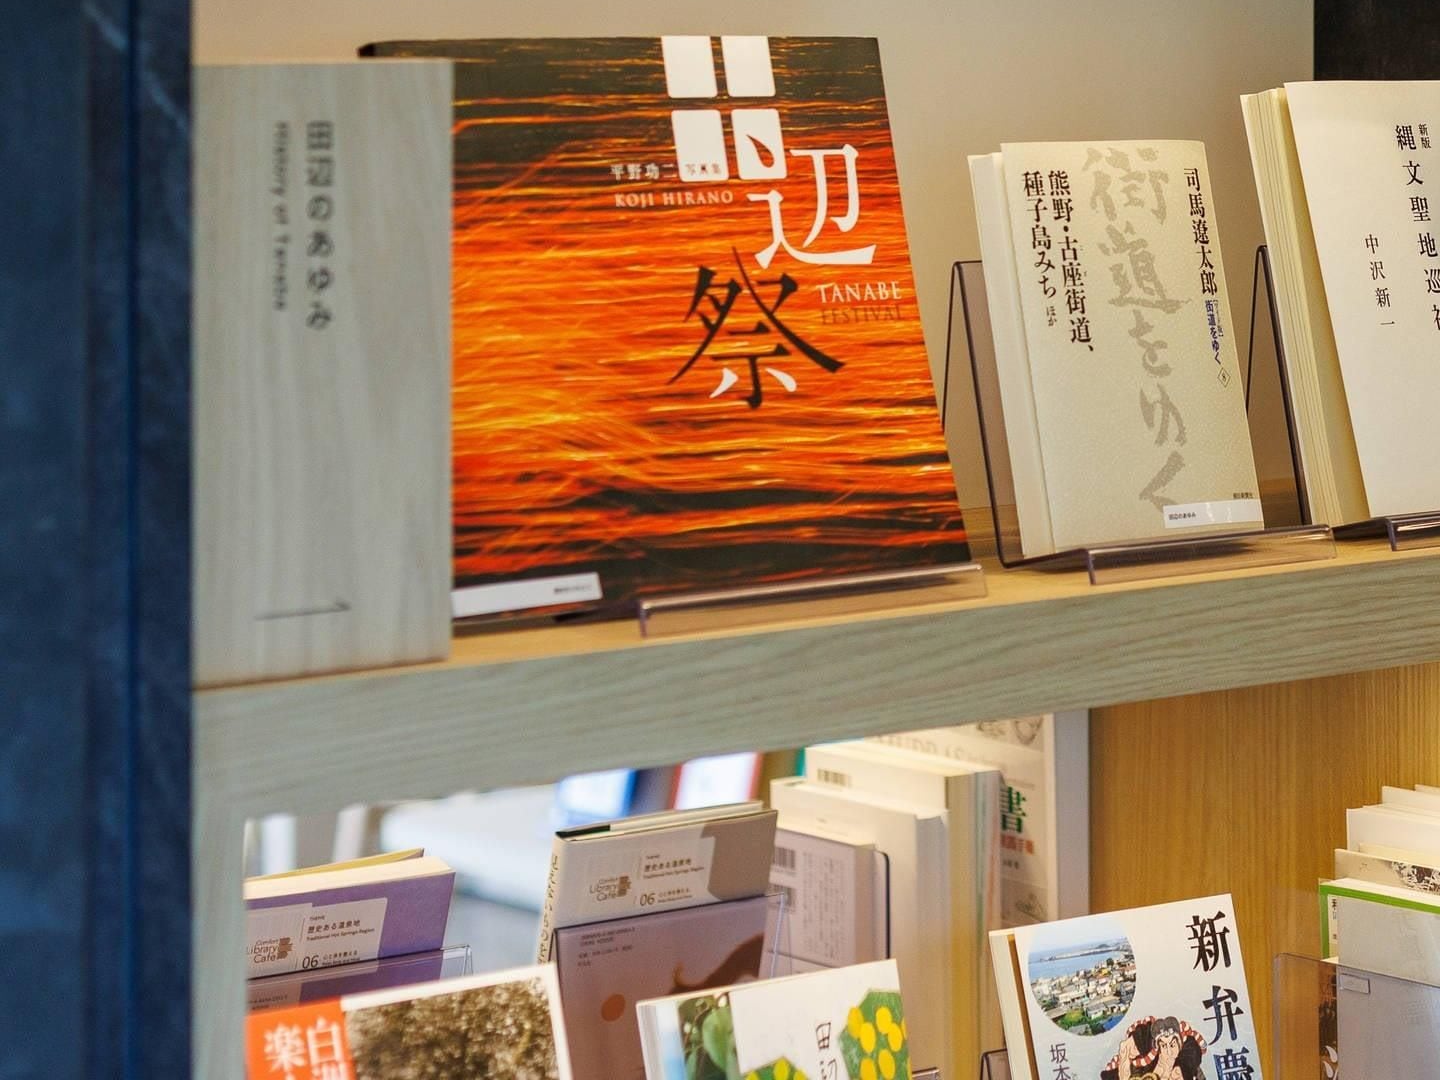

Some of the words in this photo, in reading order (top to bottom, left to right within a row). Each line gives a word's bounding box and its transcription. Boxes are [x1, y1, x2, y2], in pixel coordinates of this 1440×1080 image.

[1418, 123, 1432, 149] 新版
[614, 192, 655, 208] KOJI
[662, 190, 734, 206] HIRANO
[306, 121, 335, 331] 田辺のあゆみ
[1023, 170, 1057, 299] 種子島みち
[1183, 168, 1218, 296] 司馬遼太郎
[816, 280, 902, 304] TANABE
[1365, 233, 1396, 326] 中沢新一
[640, 893, 656, 907] 06
[253, 953, 278, 964] Cafe
[302, 955, 319, 969] 06
